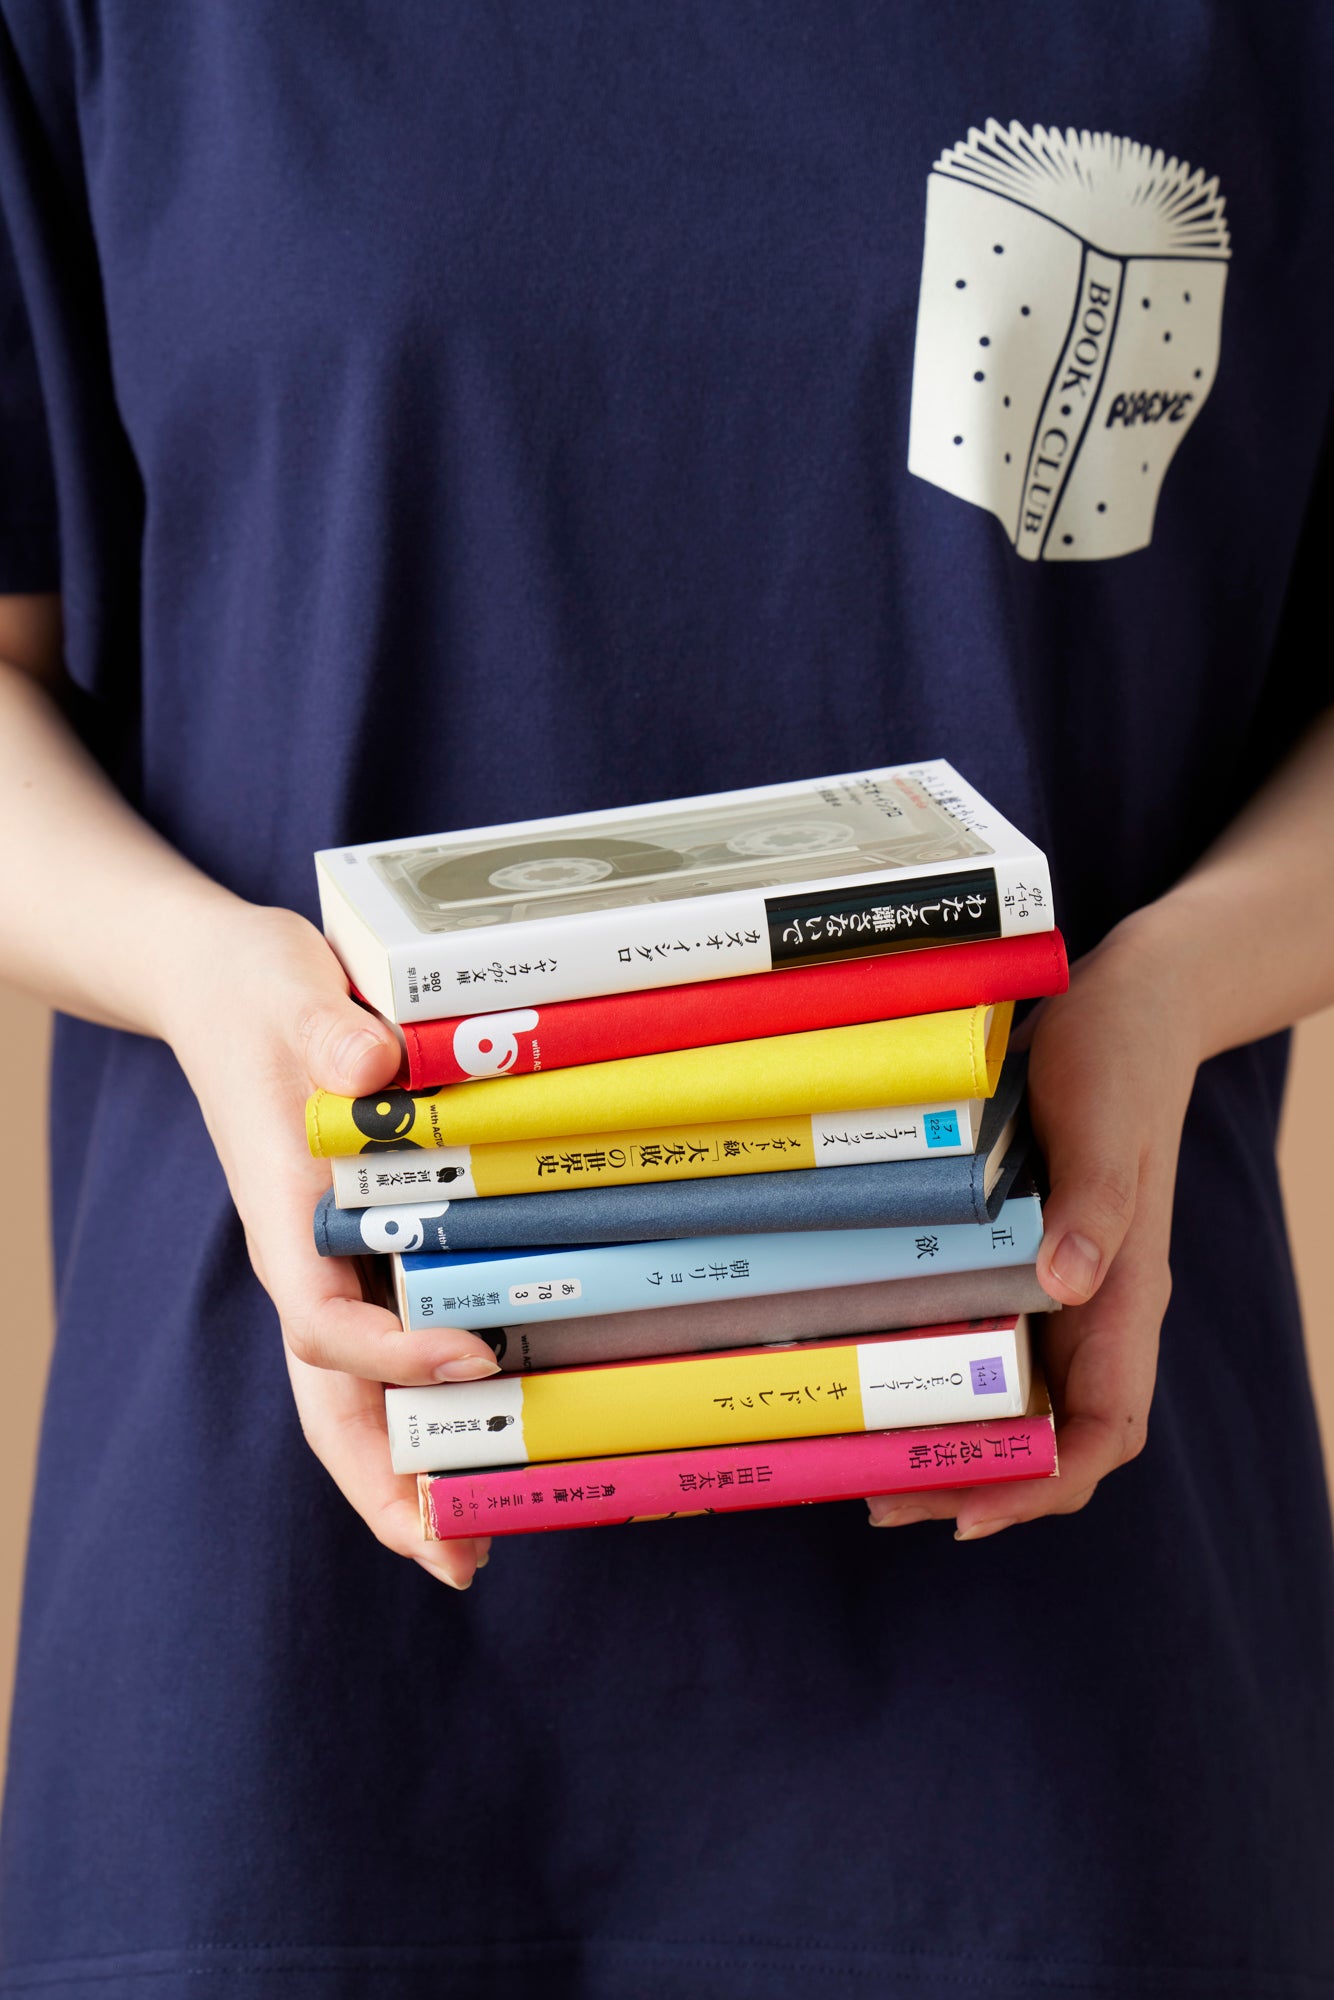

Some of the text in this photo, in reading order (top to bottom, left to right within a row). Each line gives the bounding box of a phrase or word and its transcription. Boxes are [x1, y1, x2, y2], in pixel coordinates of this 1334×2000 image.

[1024, 280, 1112, 535] BOOK CLUB
[1028, 887, 1047, 907] epi
[783, 894, 987, 945] わたしを離さないで
[617, 929, 761, 962] カズオ・イシグロ
[430, 971, 442, 993] 980
[456, 958, 558, 985] ハヤカワepi文庫
[407, 967, 420, 1004] 早川書房
[531, 1039, 541, 1060] with
[430, 1104, 439, 1125] with
[930, 1118, 941, 1141] 22-1
[358, 1168, 370, 1195] ¥980
[375, 1169, 431, 1187] 河出文庫
[437, 1226, 447, 1245] with
[646, 1258, 750, 1286] 朝井リョウ
[442, 1291, 500, 1311] 新潮文庫
[515, 1291, 529, 1299] 3
[538, 1284, 552, 1300] 78
[561, 1284, 575, 1296] あ
[420, 1296, 434, 1317] 850
[521, 1334, 530, 1355] with
[976, 1365, 987, 1387] 14-1
[713, 1381, 848, 1411] キンドレッド
[408, 1414, 421, 1448] ¥1520
[426, 1418, 482, 1436] 河出文庫
[908, 1434, 1032, 1469] 江戸忍法帖
[679, 1465, 773, 1492] 山田風太郎
[487, 1494, 524, 1510] 三五六
[552, 1483, 616, 1504] 角川文庫
[451, 1496, 464, 1518] 420
